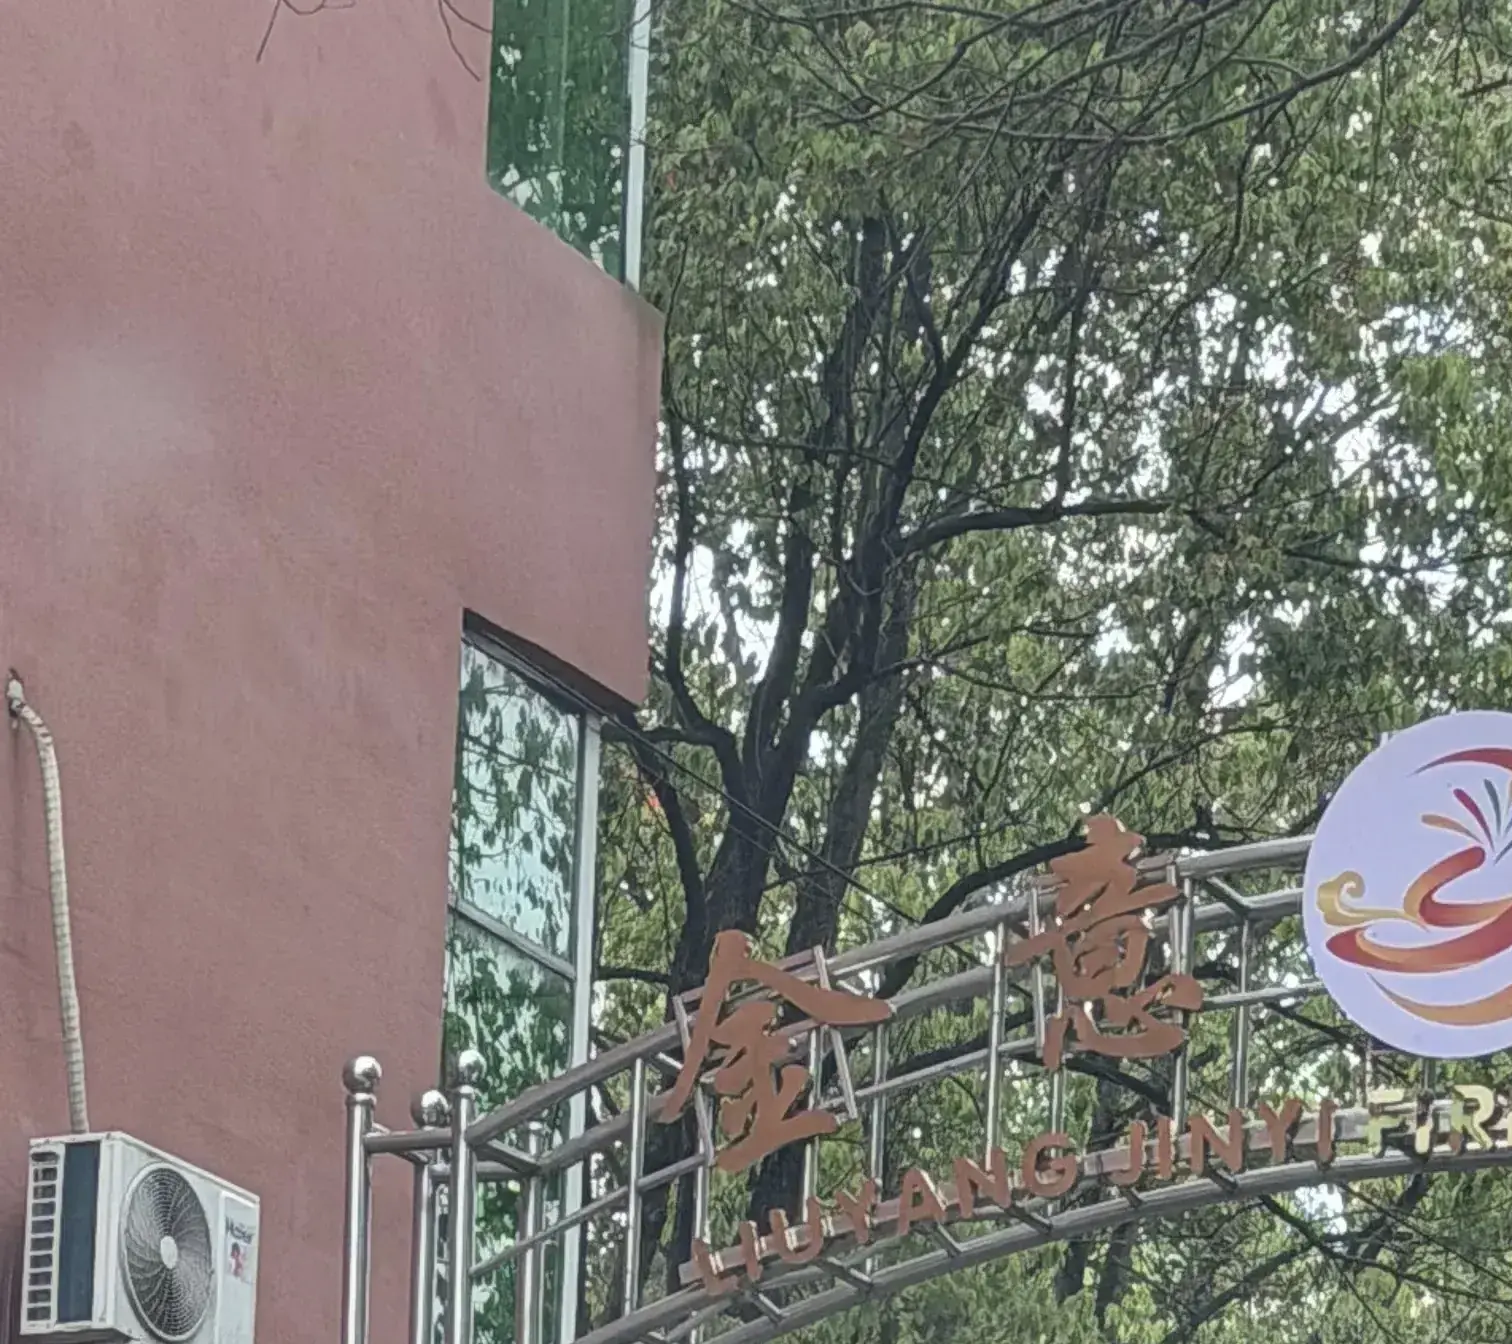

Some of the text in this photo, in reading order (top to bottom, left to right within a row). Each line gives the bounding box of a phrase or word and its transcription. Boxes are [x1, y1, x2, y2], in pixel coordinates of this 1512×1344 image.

[660, 814, 1203, 1172] 金意
[690, 1131, 1079, 1296] LIUYANG
[1110, 1098, 1337, 1186] JINYI
